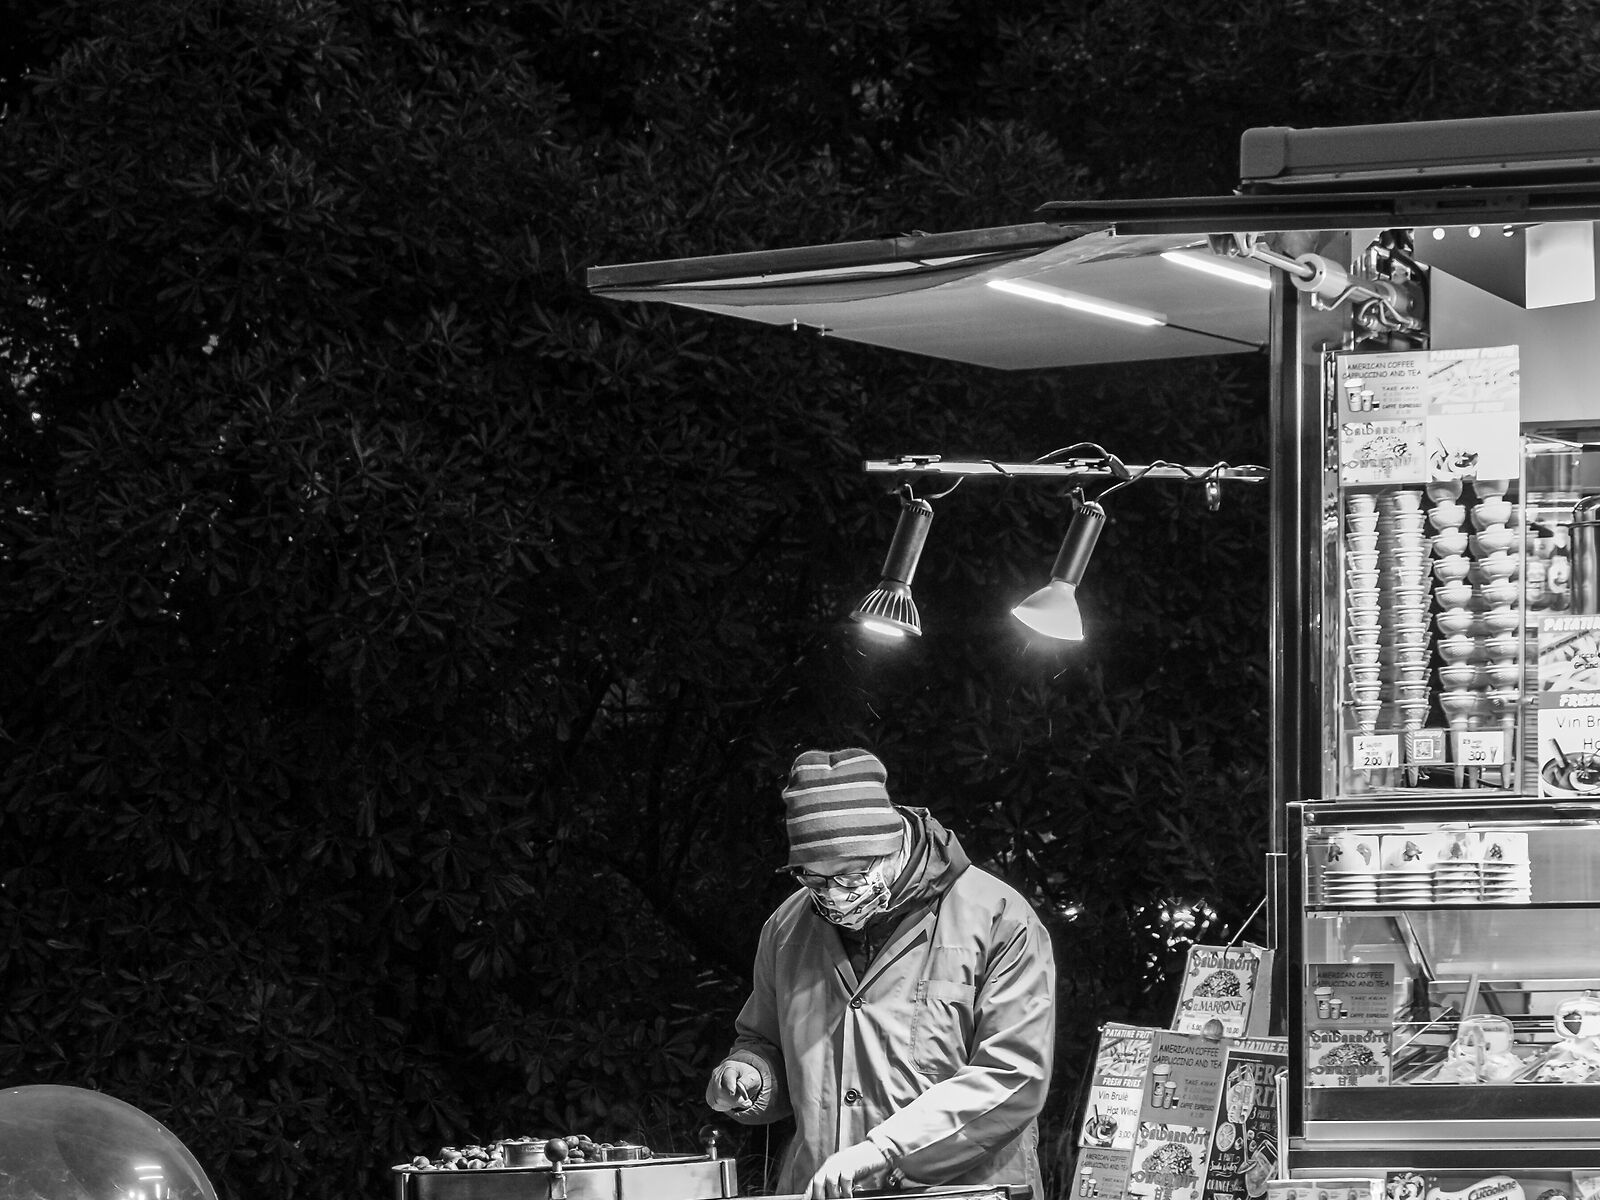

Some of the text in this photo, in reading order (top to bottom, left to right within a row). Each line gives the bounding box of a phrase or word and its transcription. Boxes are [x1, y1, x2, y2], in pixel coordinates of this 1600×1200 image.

[1347, 360, 1415, 370] AMERICAN COFFEE
[1556, 715, 1581, 728] Vin
[1356, 971, 1384, 979] COFFEE
[1201, 1000, 1242, 1014] MARRONE
[1160, 1044, 1220, 1057] AMERICAN COFFEE
[1152, 1055, 1194, 1067] CAPPUCCINO
[1195, 1059, 1209, 1068] AND
[1210, 1059, 1222, 1069] TEA
[1098, 1091, 1110, 1100] Vin
